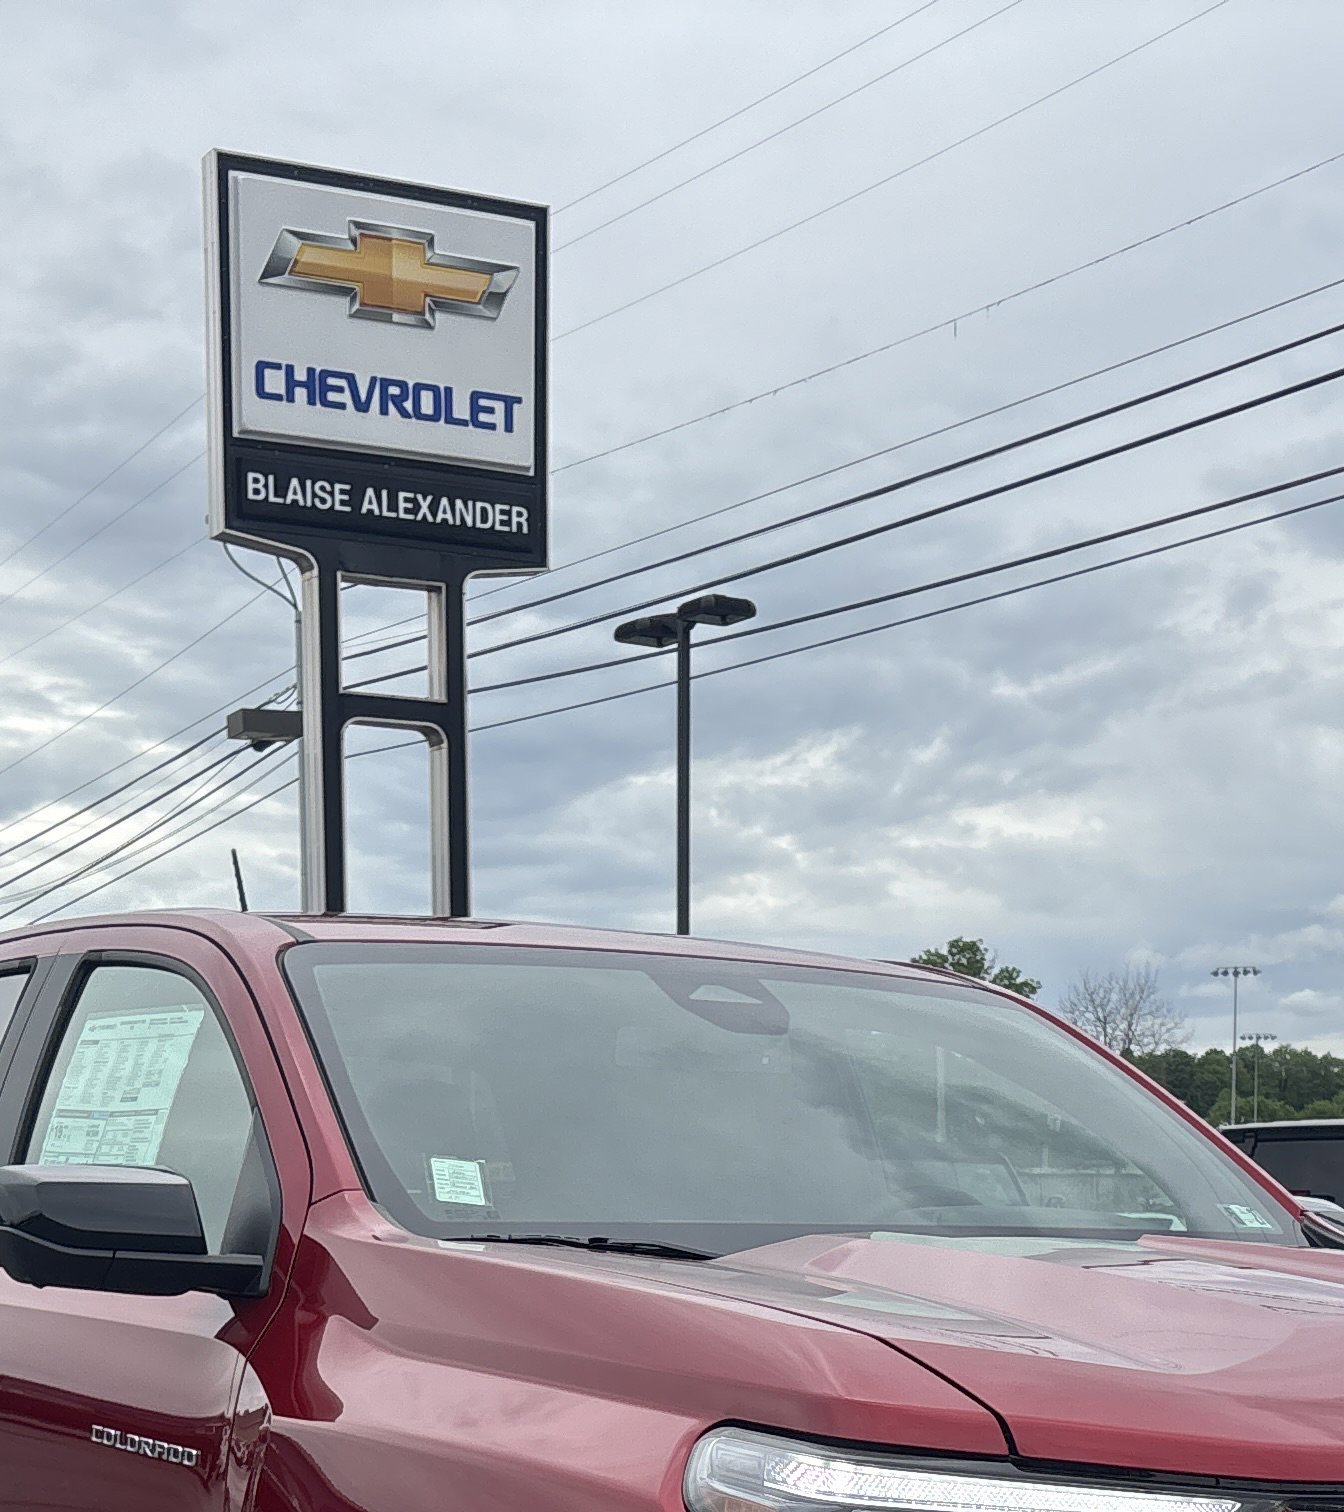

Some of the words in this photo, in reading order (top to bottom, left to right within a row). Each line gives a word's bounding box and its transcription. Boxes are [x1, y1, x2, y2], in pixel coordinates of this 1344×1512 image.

[255, 360, 523, 433] CHEVROLET
[246, 471, 352, 512] BLAISE
[360, 487, 529, 535] ALEXANDER
[90, 1424, 198, 1467] COLORADO
